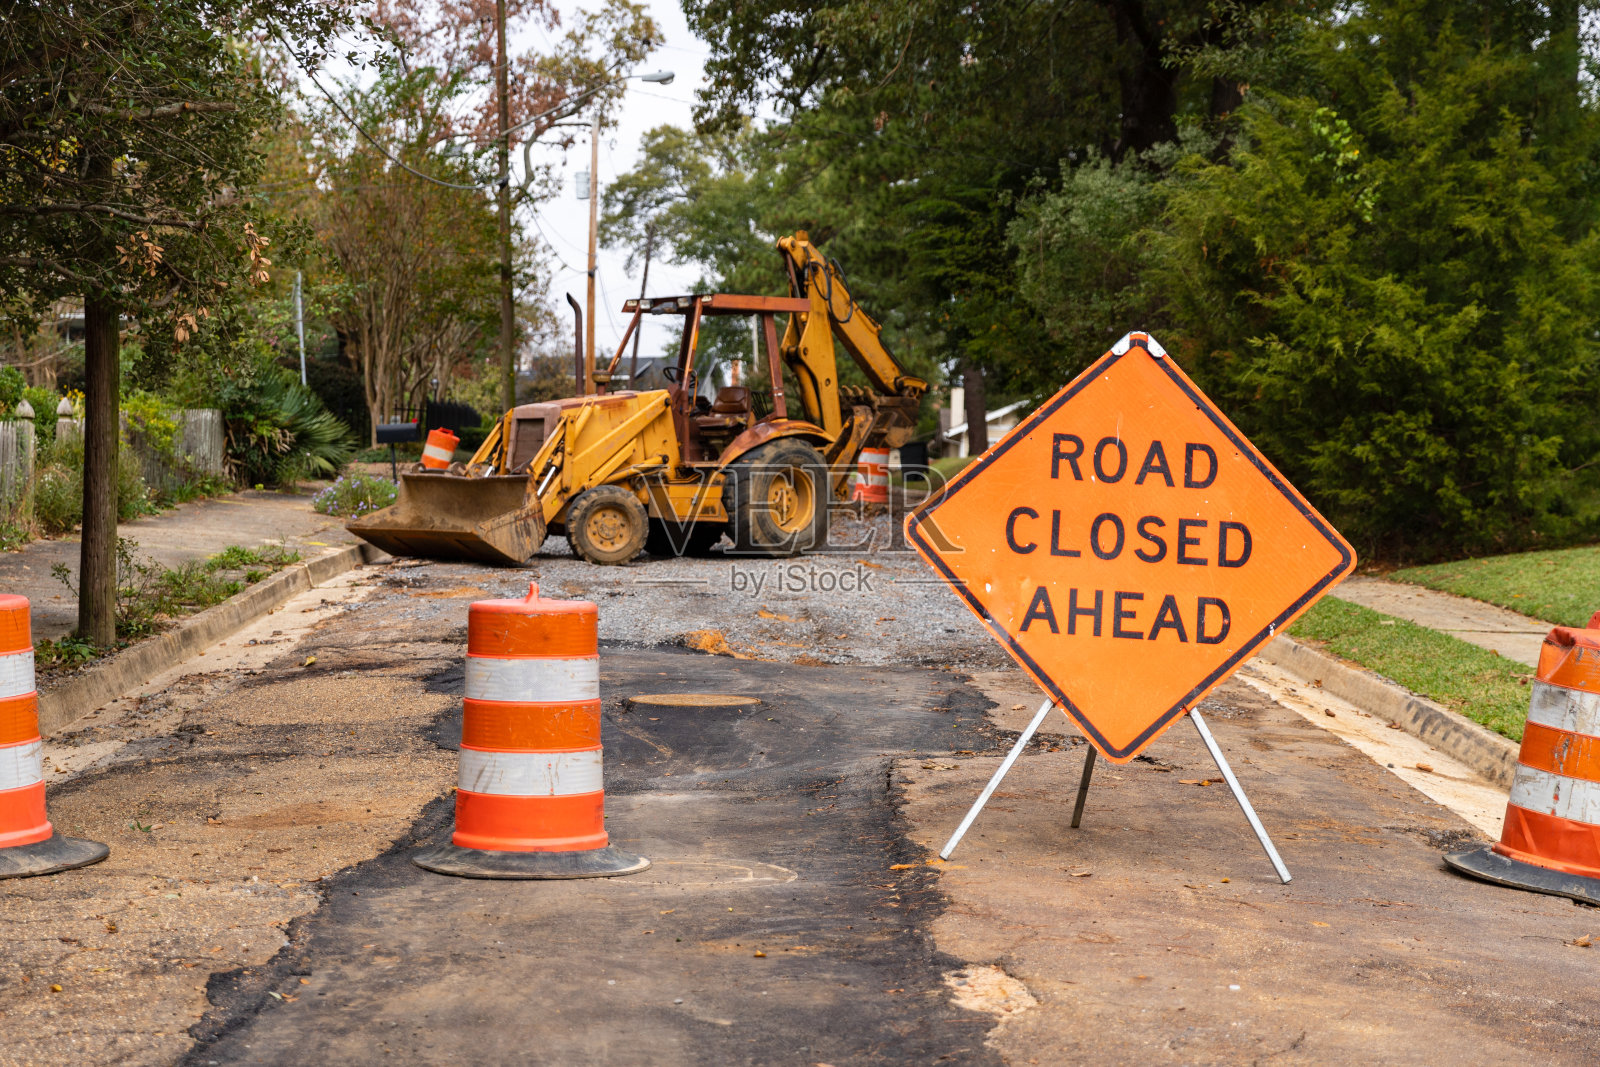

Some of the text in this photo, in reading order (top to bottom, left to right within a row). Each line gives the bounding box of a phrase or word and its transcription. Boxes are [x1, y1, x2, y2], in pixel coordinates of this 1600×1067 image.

[1050, 432, 1219, 489] ROAD
[1005, 506, 1253, 569] CLOSED
[1019, 585, 1232, 645] AHEAD
